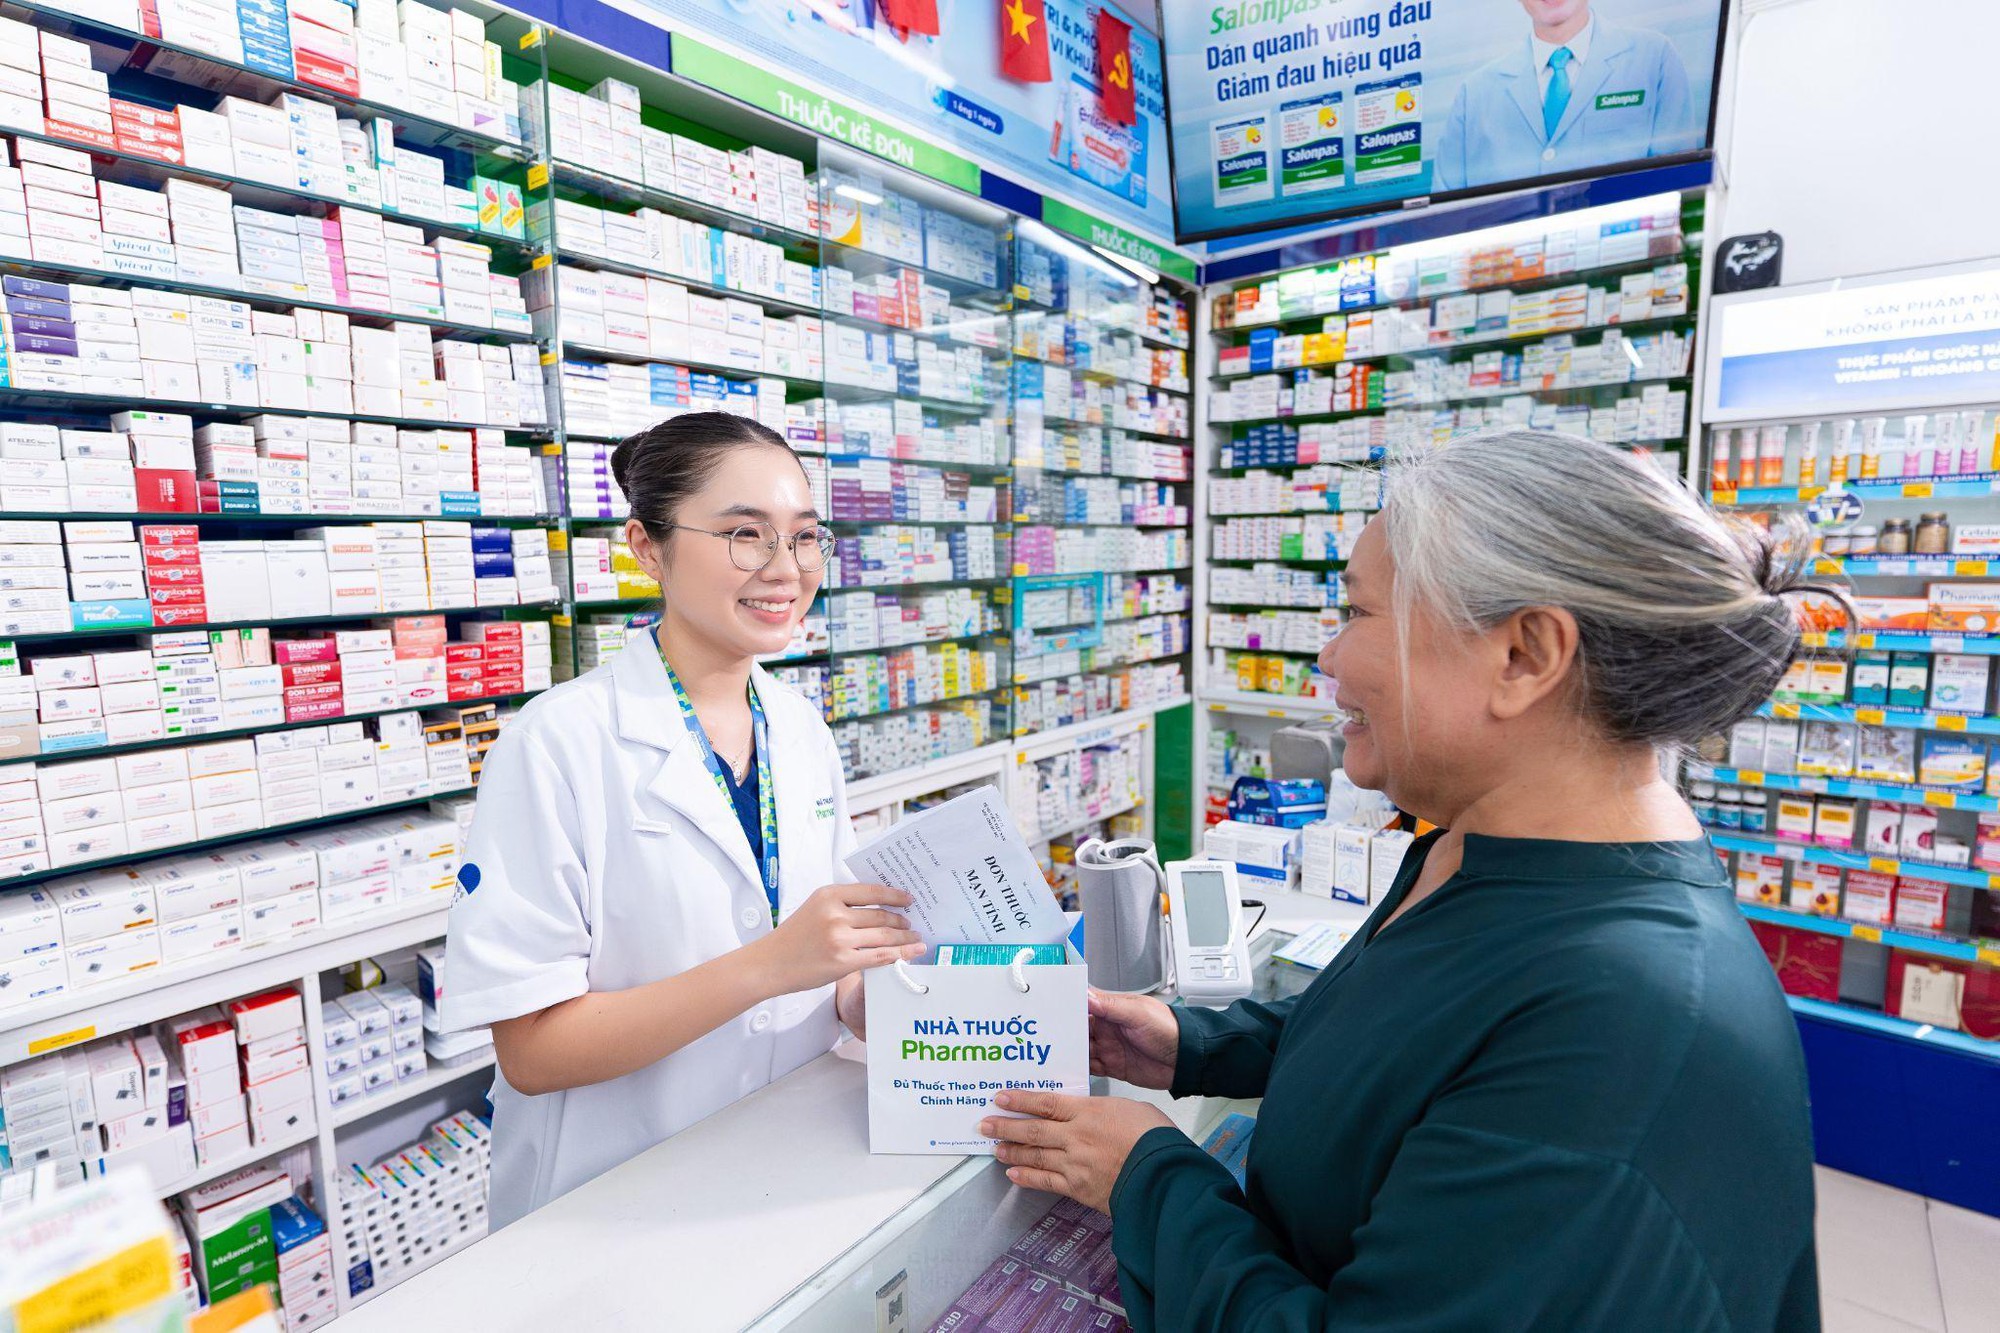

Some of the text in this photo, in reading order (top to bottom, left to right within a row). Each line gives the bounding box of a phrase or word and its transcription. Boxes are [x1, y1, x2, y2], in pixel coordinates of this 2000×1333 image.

[1206, 0, 1432, 70] Dán quanh vùng đau
[1217, 33, 1422, 102] Giảm đau hiệu quả
[1601, 94, 1640, 107] Salonpas
[776, 90, 915, 167] THUỐC KÊ ĐƠN
[1360, 127, 1416, 151] Salonpas
[1221, 154, 1264, 173] Salonpas
[1286, 143, 1339, 165] Salonpas
[984, 855, 1008, 884] ĐƠN
[964, 869, 988, 900] MẠN
[981, 900, 1007, 934] TÍNH
[914, 1015, 1038, 1036] NHÀ THUỐC
[902, 1037, 1052, 1065] Pharmacity
[893, 1078, 910, 1090] Đủ
[912, 1079, 946, 1091] Thuốc
[948, 1081, 976, 1091] Theo
[979, 1080, 1003, 1091] Đơn
[1037, 1079, 1064, 1091] Viện
[920, 1095, 954, 1106] Chính
[956, 1095, 987, 1107] Hãng
[1015, 1216, 1057, 1252] Telfast HD
[1046, 1227, 1087, 1264] Telfast HD
